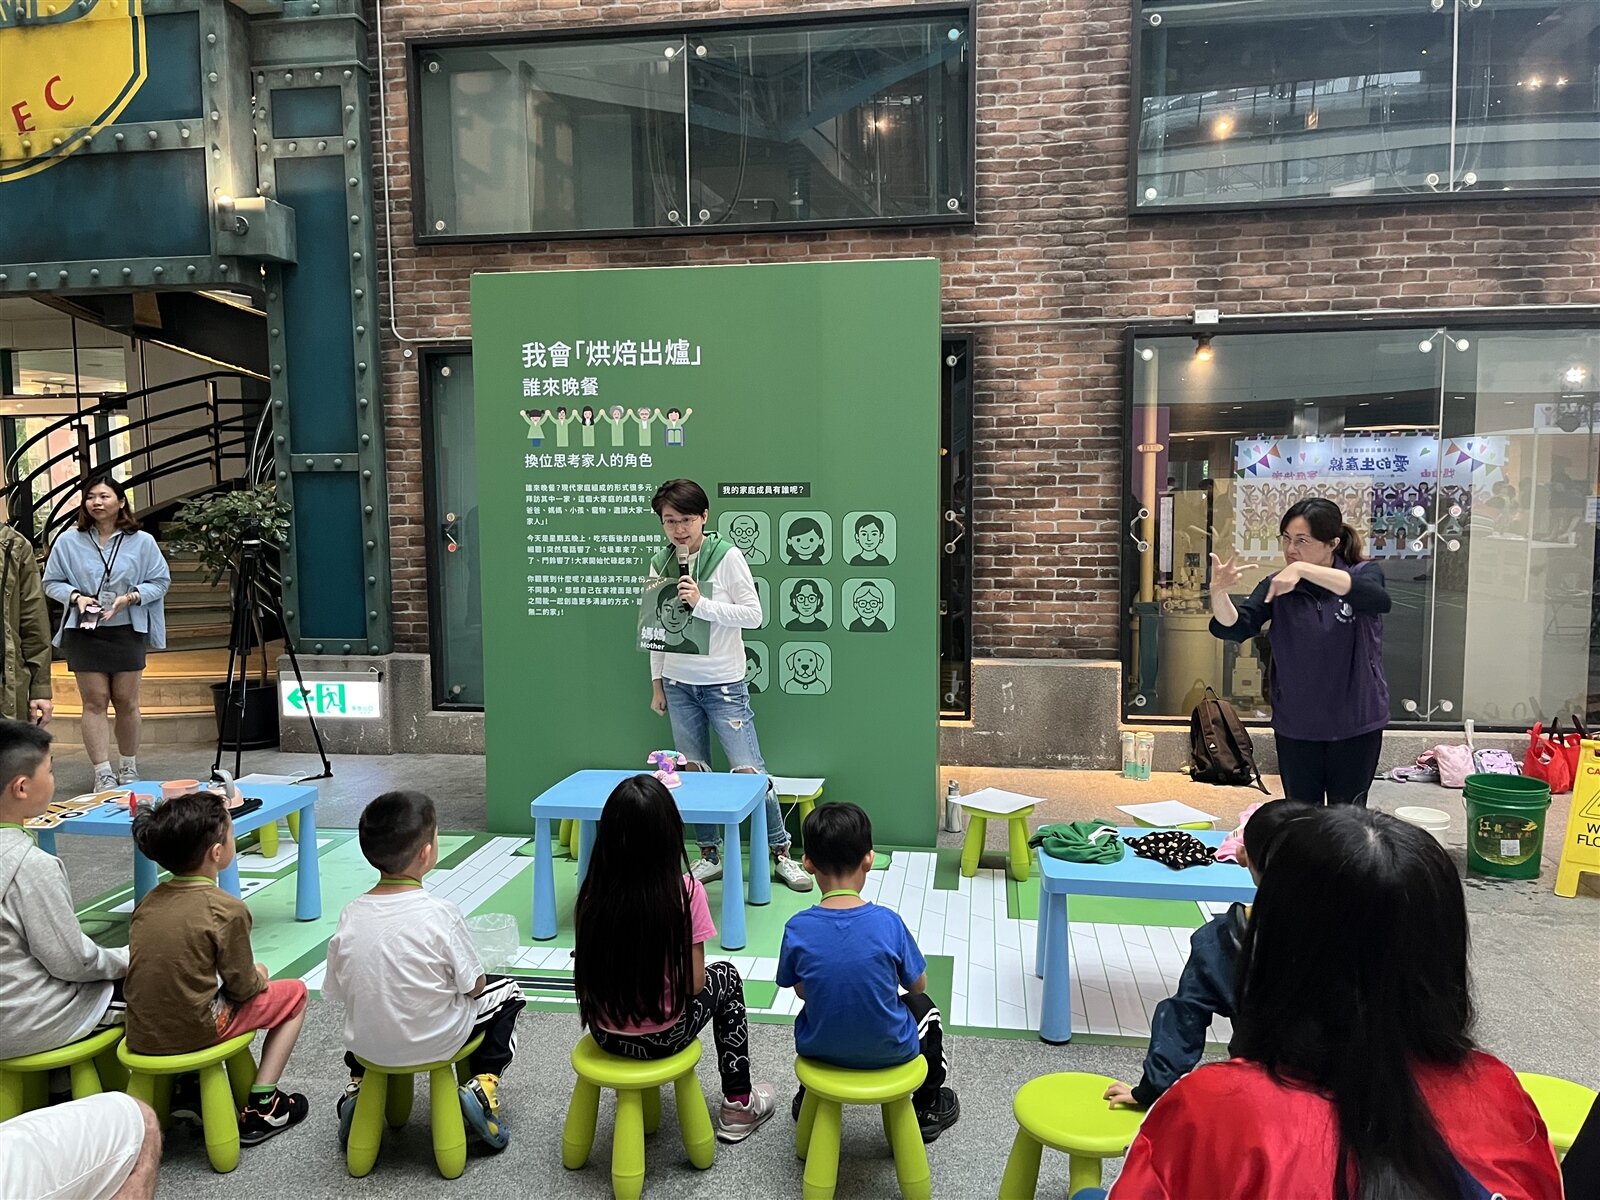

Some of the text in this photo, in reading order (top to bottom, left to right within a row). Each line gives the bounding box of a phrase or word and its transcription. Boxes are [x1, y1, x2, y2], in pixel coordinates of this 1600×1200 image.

[522, 338, 701, 368] 我會「烘焙出爐」
[522, 377, 599, 397] 誰來晚餐
[525, 453, 653, 469] 換位思考家人的角色
[641, 626, 666, 642] 媽媽
[640, 641, 665, 650] Mother
